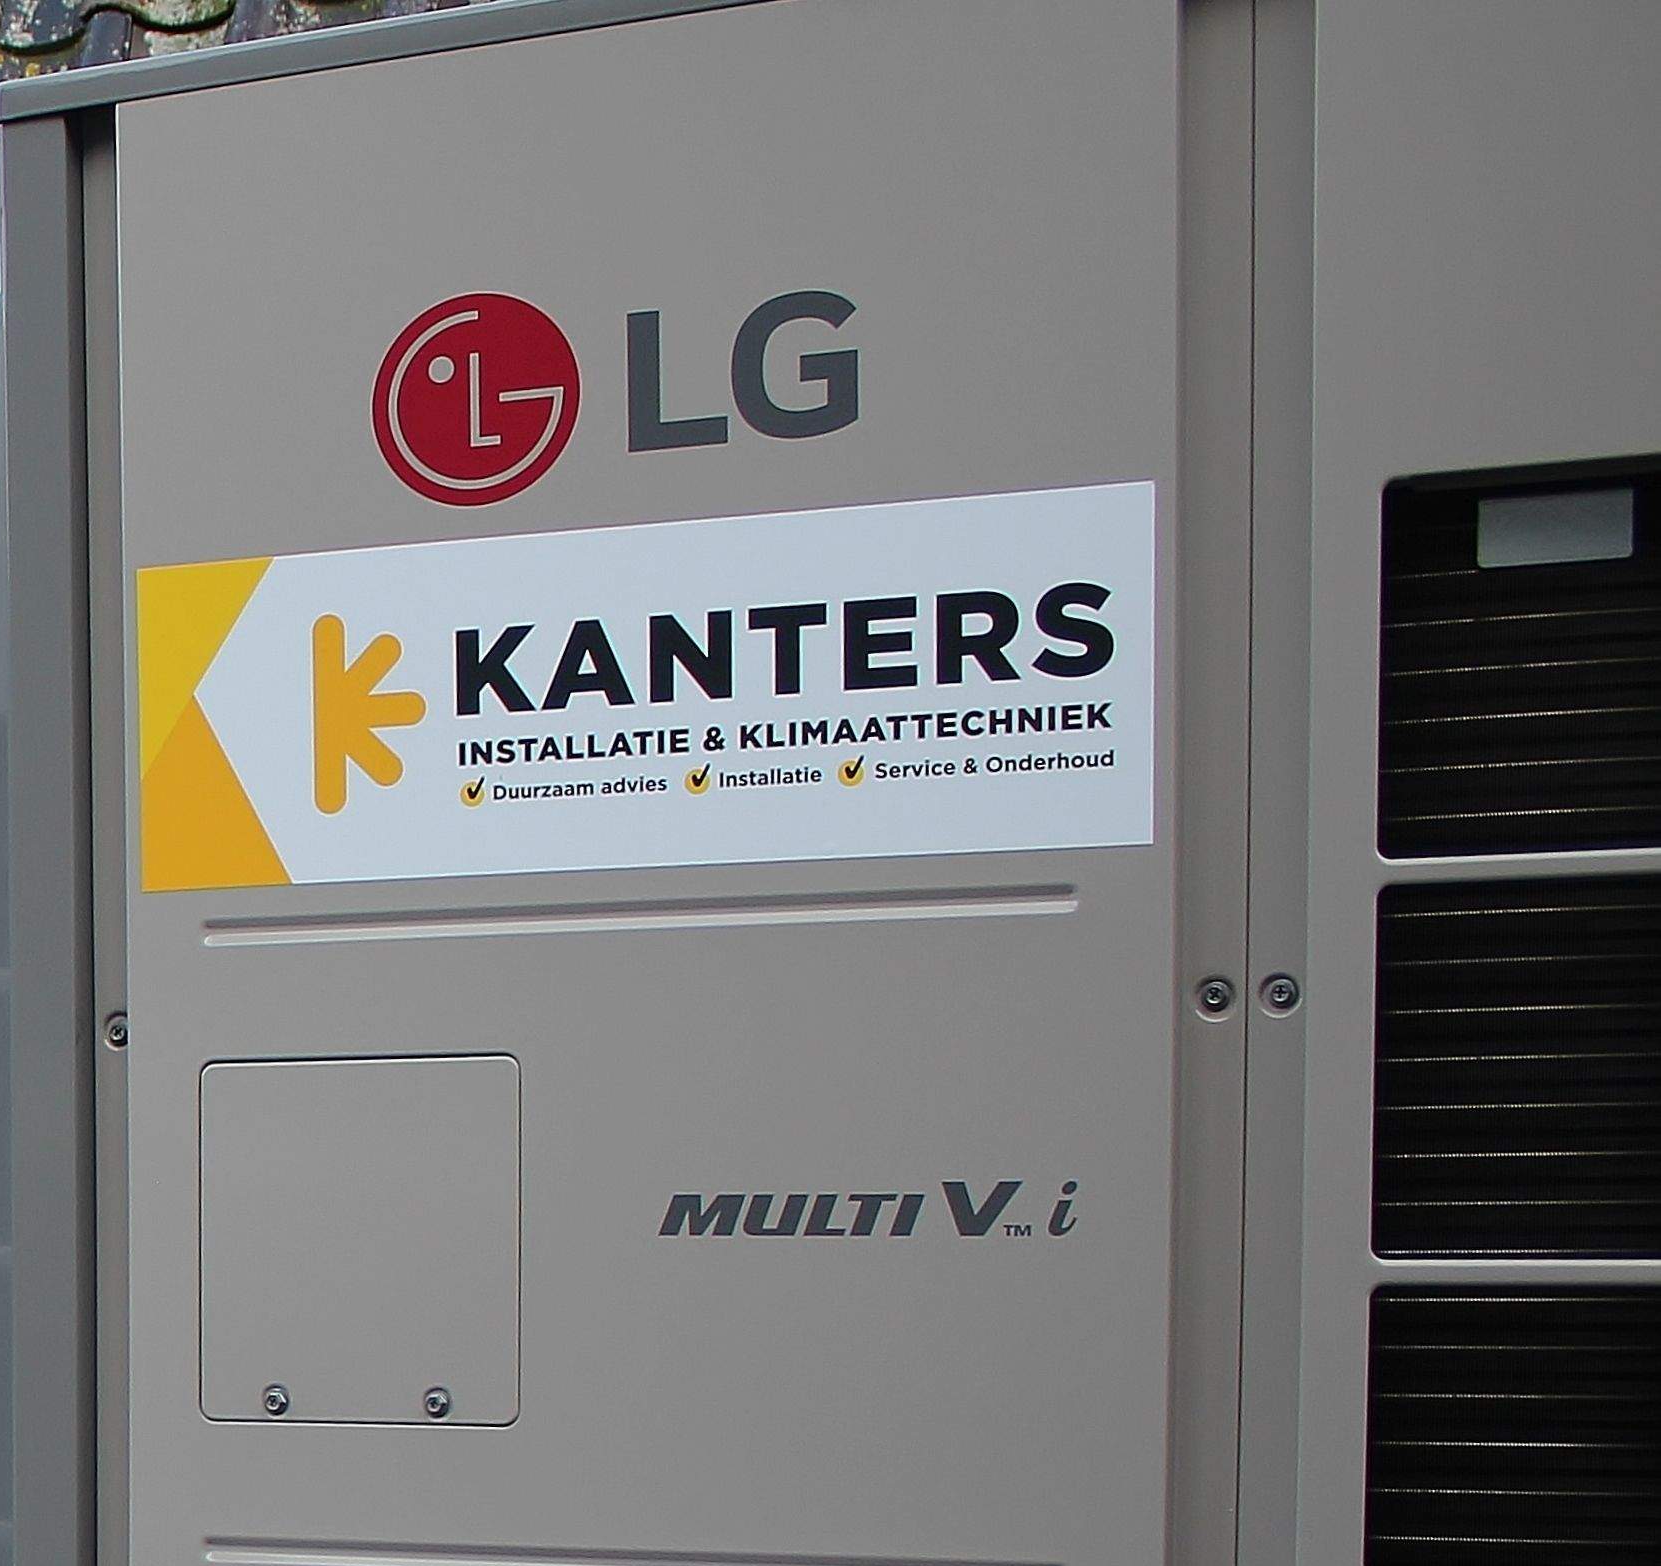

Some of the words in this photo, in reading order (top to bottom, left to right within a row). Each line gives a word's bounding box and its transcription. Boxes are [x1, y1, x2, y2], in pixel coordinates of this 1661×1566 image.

[626, 290, 861, 454] LG
[455, 582, 1115, 716] KANTERS
[457, 727, 692, 767] INSTALLATIE
[703, 726, 726, 752] &
[738, 703, 1113, 751] KLIMAATTECHNIEK
[492, 779, 596, 802] Duurzaam
[601, 772, 668, 795] advies
[718, 765, 822, 790] Installatie
[874, 759, 957, 780] Service
[963, 759, 978, 775] &
[985, 750, 1114, 772] Onderhoud
[659, 1192, 925, 1237] MULTI
[1048, 1181, 1079, 1236] i
